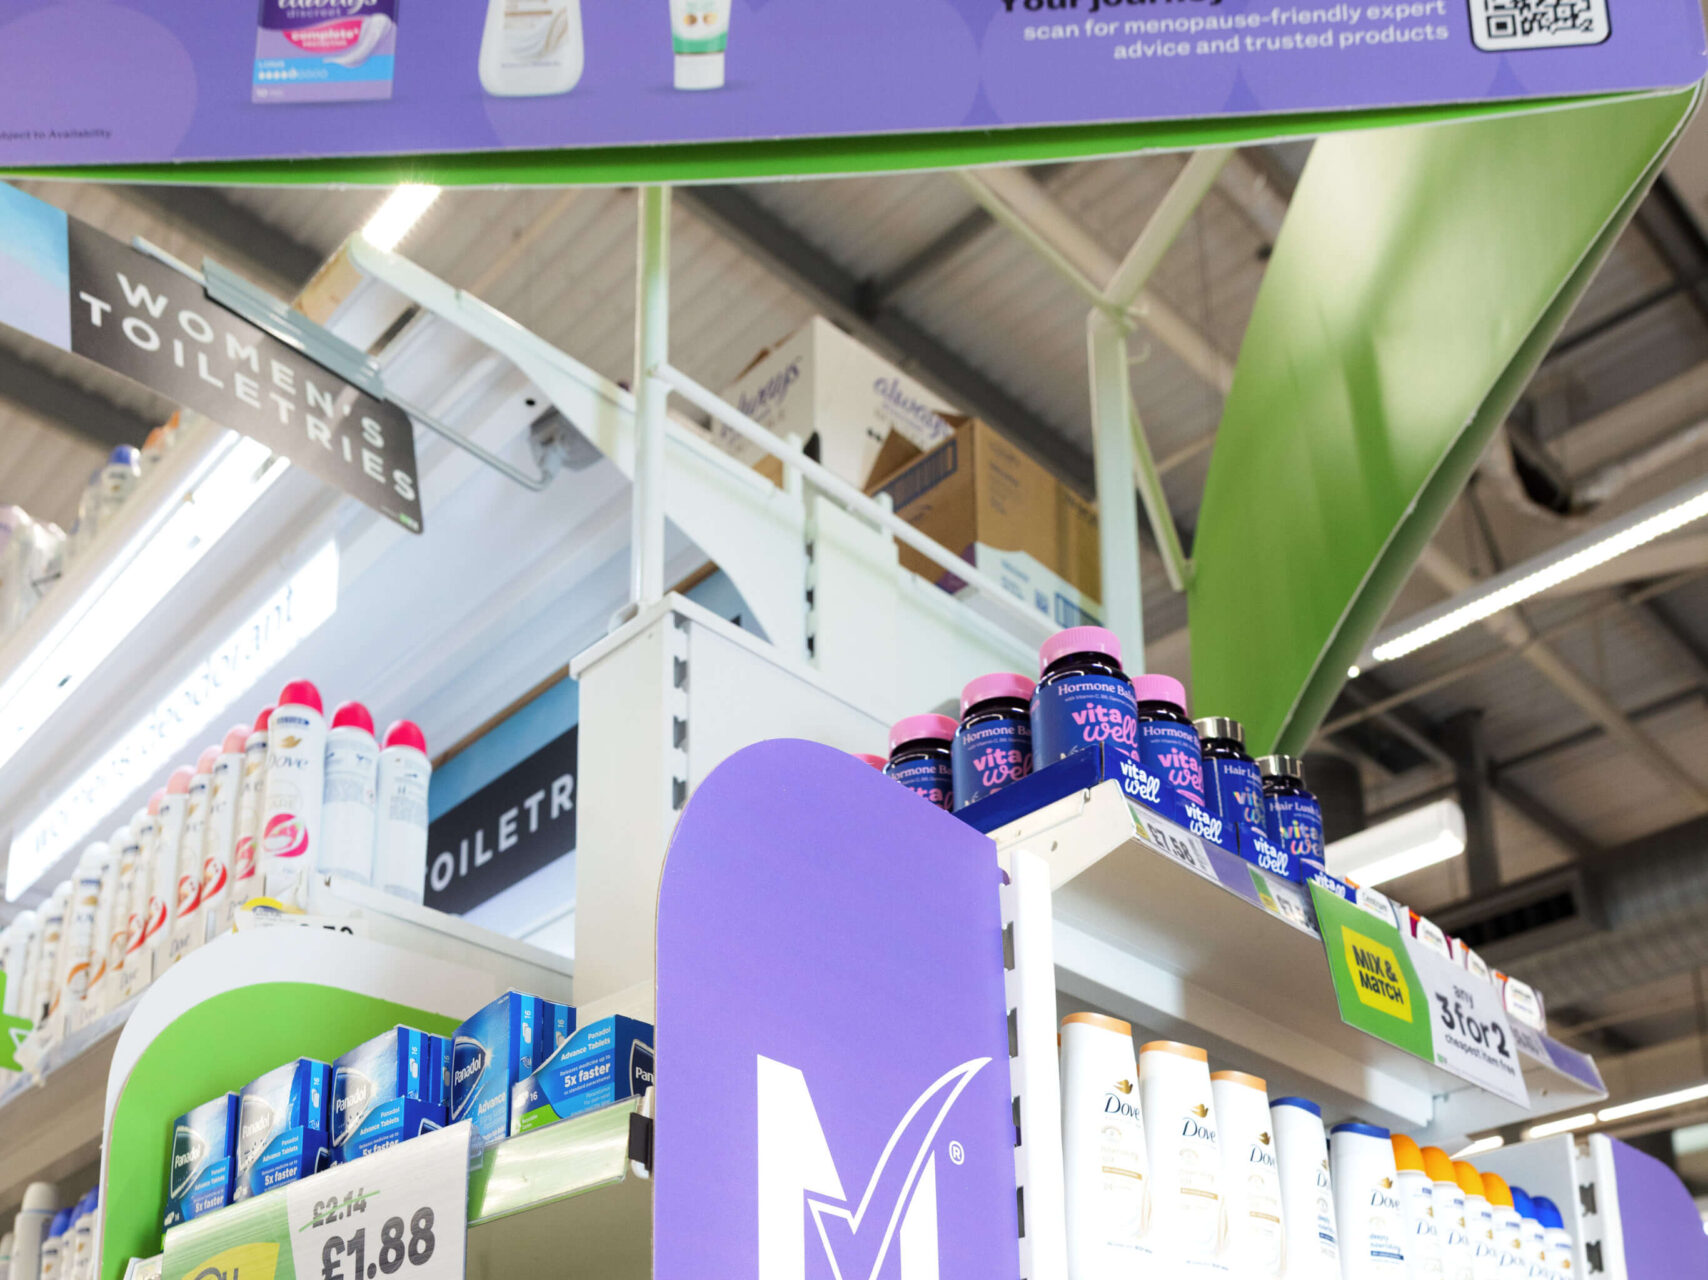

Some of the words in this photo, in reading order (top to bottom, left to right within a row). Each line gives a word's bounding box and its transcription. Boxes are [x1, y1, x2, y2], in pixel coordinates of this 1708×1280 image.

[1023, 23, 1080, 41] scan
[1085, 18, 1120, 37] for
[1125, 3, 1361, 34] menopause-friendly
[1366, 0, 1447, 22] expert
[1114, 39, 1191, 60] advice
[1196, 34, 1240, 54] and
[1245, 28, 1334, 51] trusted
[1339, 22, 1449, 49] products
[116, 271, 385, 449] WOMEN'S
[79, 290, 416, 501] TOILETRIES
[1058, 682, 1115, 696] Hormone
[1072, 702, 1123, 725] vita
[963, 725, 1014, 745] Hormone
[1083, 715, 1138, 748] well
[973, 748, 1022, 771] vita
[1120, 759, 1148, 782] vita
[1223, 764, 1246, 776] Hair
[1124, 775, 1161, 803] well
[1185, 802, 1211, 825] vita
[425, 774, 575, 893] OILETR
[1190, 817, 1223, 844] well
[1253, 836, 1278, 858] vita
[1258, 851, 1290, 876] well
[1352, 944, 1383, 976] MIX
[1385, 959, 1398, 982] &
[1452, 985, 1474, 1009] any
[561, 1046, 587, 1061] Advance
[588, 1037, 611, 1050] Tablets
[453, 1053, 482, 1086] Panadol
[564, 1074, 577, 1088] 5x
[578, 1062, 611, 1083] faster
[335, 1084, 367, 1114] Panadol
[477, 1091, 507, 1115] Advance
[1104, 1092, 1141, 1121] Dove
[1182, 1116, 1217, 1143] Dove
[311, 1187, 367, 1229] £2.14
